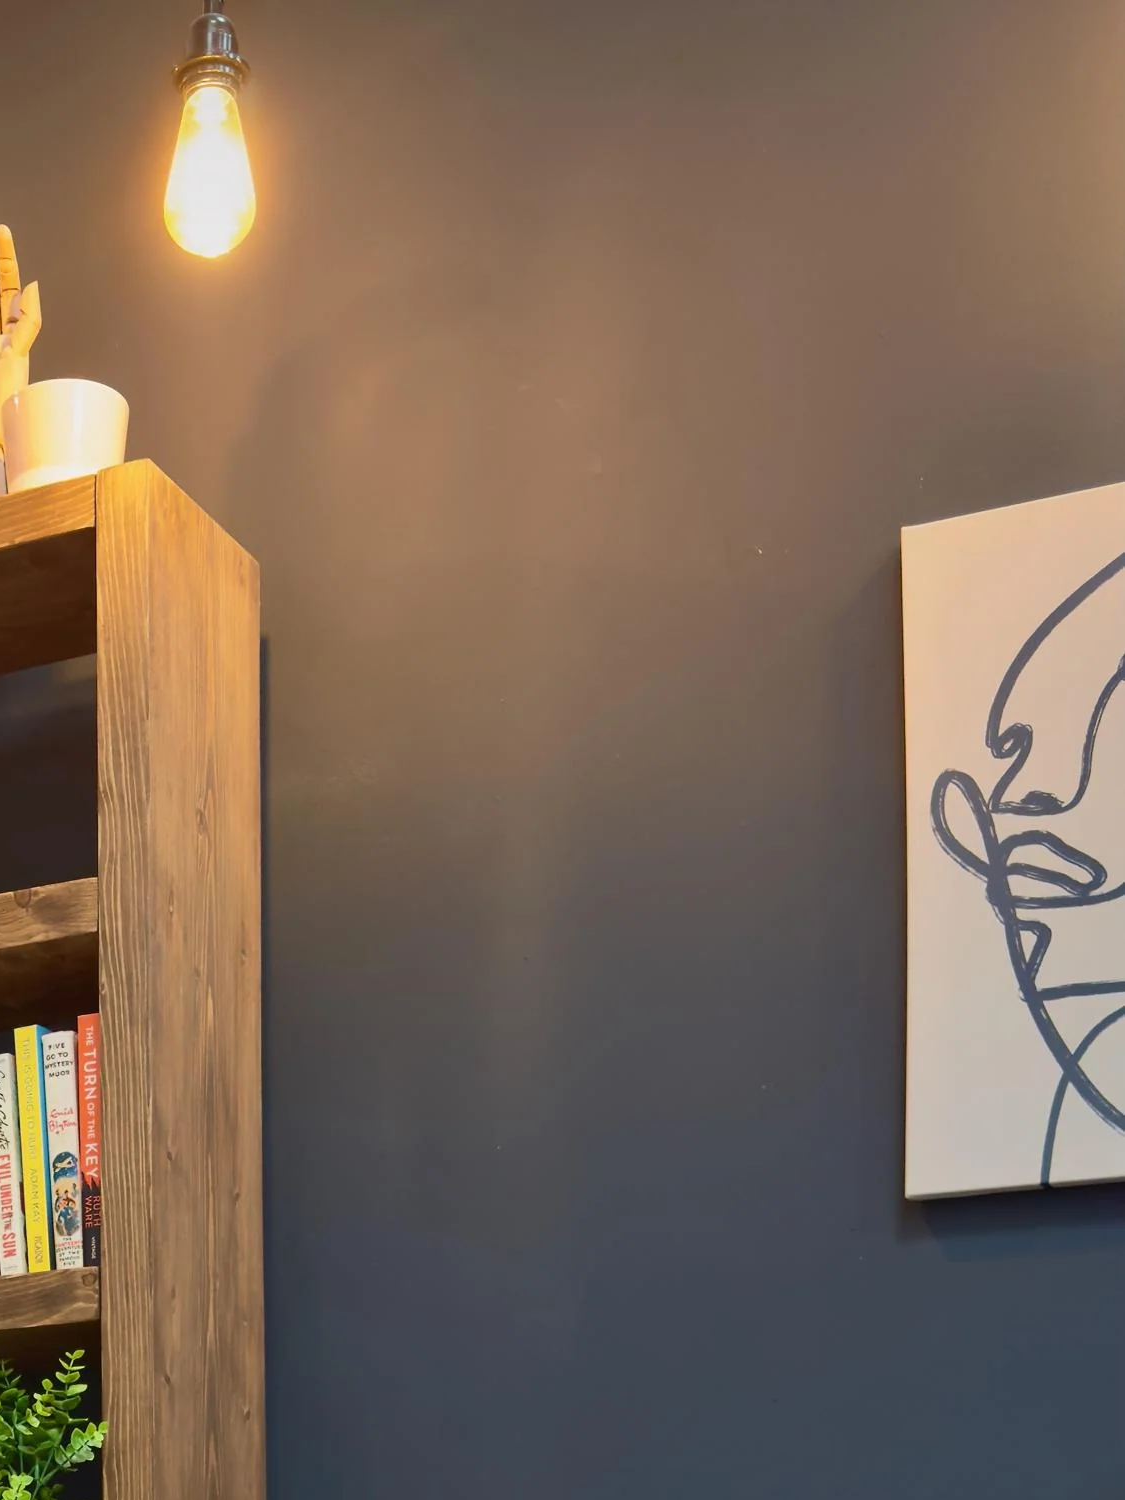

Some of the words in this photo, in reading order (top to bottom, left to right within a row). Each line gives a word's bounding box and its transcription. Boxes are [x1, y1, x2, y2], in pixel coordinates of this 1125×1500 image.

[85, 1025, 94, 1046] THE
[22, 1038, 30, 1060] THIS
[25, 1064, 31, 1074] IS
[44, 1061, 74, 1069] MYSTERY
[83, 1050, 97, 1100] TURN
[24, 1077, 34, 1112] GOING
[86, 1103, 95, 1119] OF
[27, 1117, 34, 1130] TO
[87, 1120, 96, 1139] THE
[85, 1143, 98, 1178] KEY
[30, 1168, 39, 1199] ADAM
[0, 1183, 13, 1220] UNDER
[85, 1195, 93, 1228] WARE
[93, 1195, 101, 1227] RUTH
[32, 1202, 40, 1224] KAY
[4, 1219, 12, 1231] THE
[2, 1232, 17, 1258] SUN
